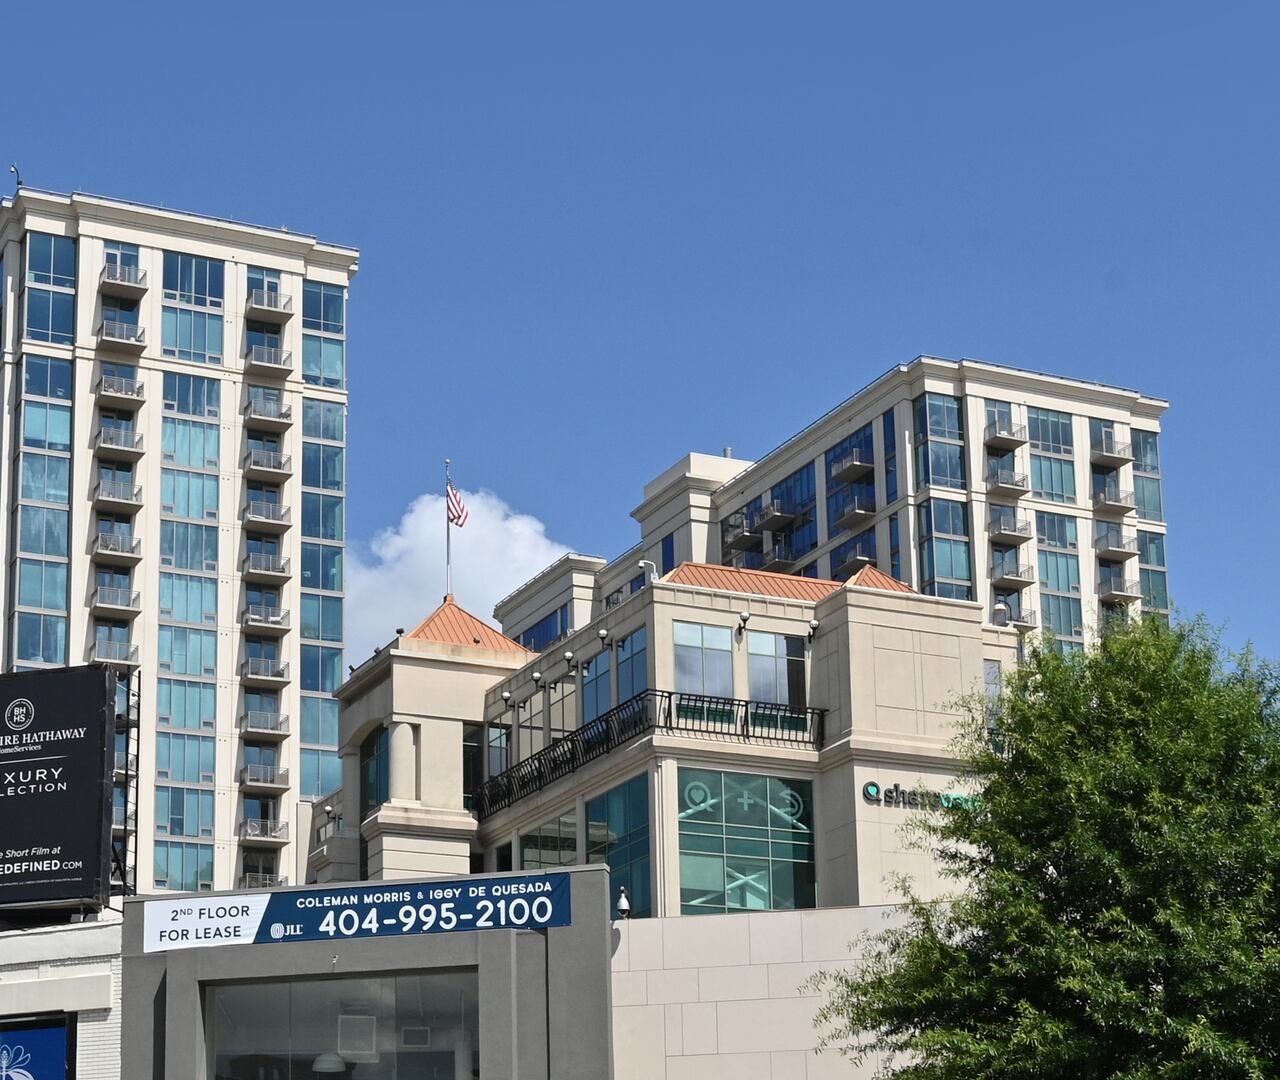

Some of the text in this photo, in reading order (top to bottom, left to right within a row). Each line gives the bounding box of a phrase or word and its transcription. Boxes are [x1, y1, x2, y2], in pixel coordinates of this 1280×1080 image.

[22, 727, 87, 744] HATHAWAY
[5, 849, 29, 859] Short
[31, 847, 50, 856] Film
[51, 846, 61, 855] at
[296, 881, 553, 908] COLEMAN MORRIS & IGGY DE QUESADA
[170, 905, 250, 922] 2ND FLOOR
[318, 896, 553, 937] 404-995-2100
[159, 926, 242, 942] FOR LEASE
